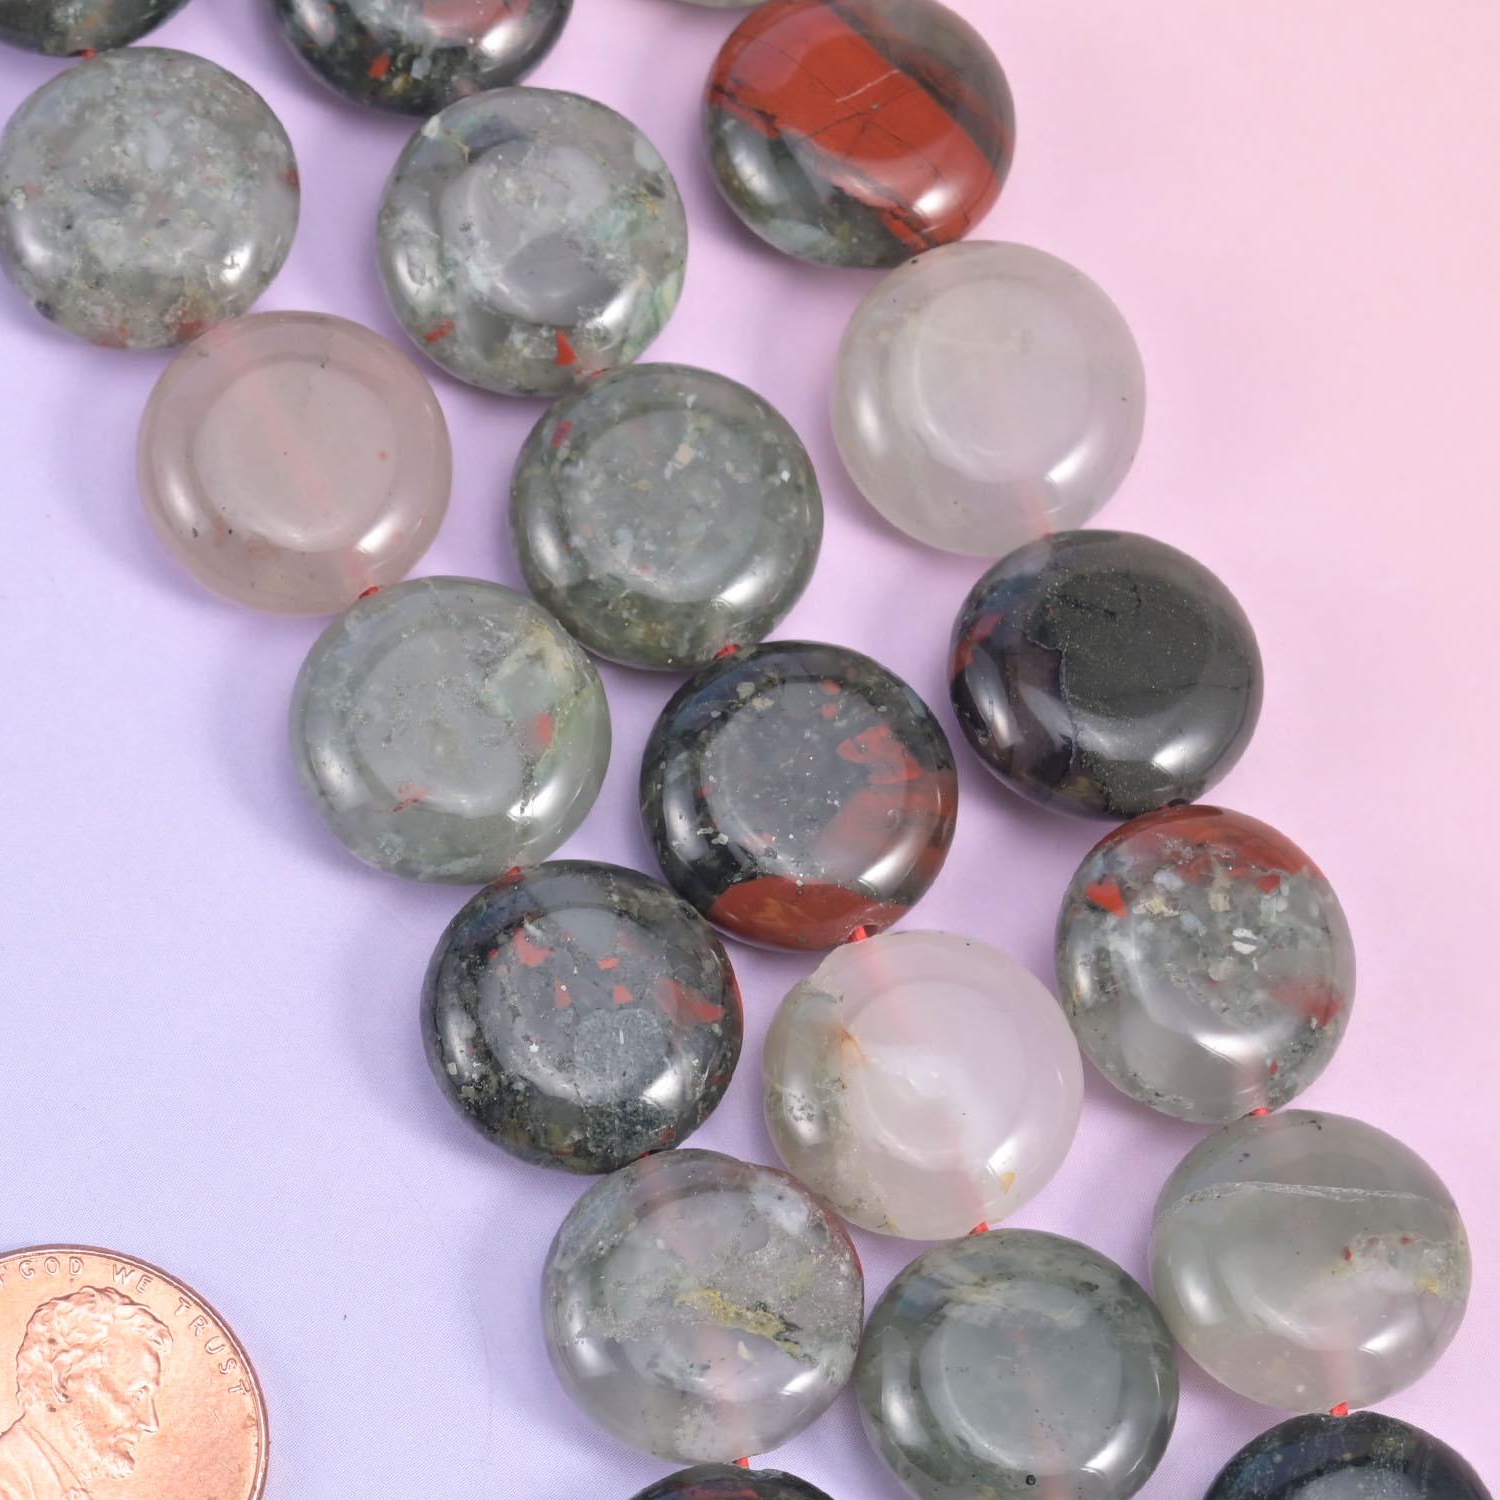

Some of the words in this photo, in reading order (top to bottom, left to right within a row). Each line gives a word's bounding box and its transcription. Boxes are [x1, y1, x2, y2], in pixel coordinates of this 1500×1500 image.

[18, 1256, 85, 1280] GOD
[111, 1262, 154, 1295] WE
[173, 1297, 252, 1397] TRUST
